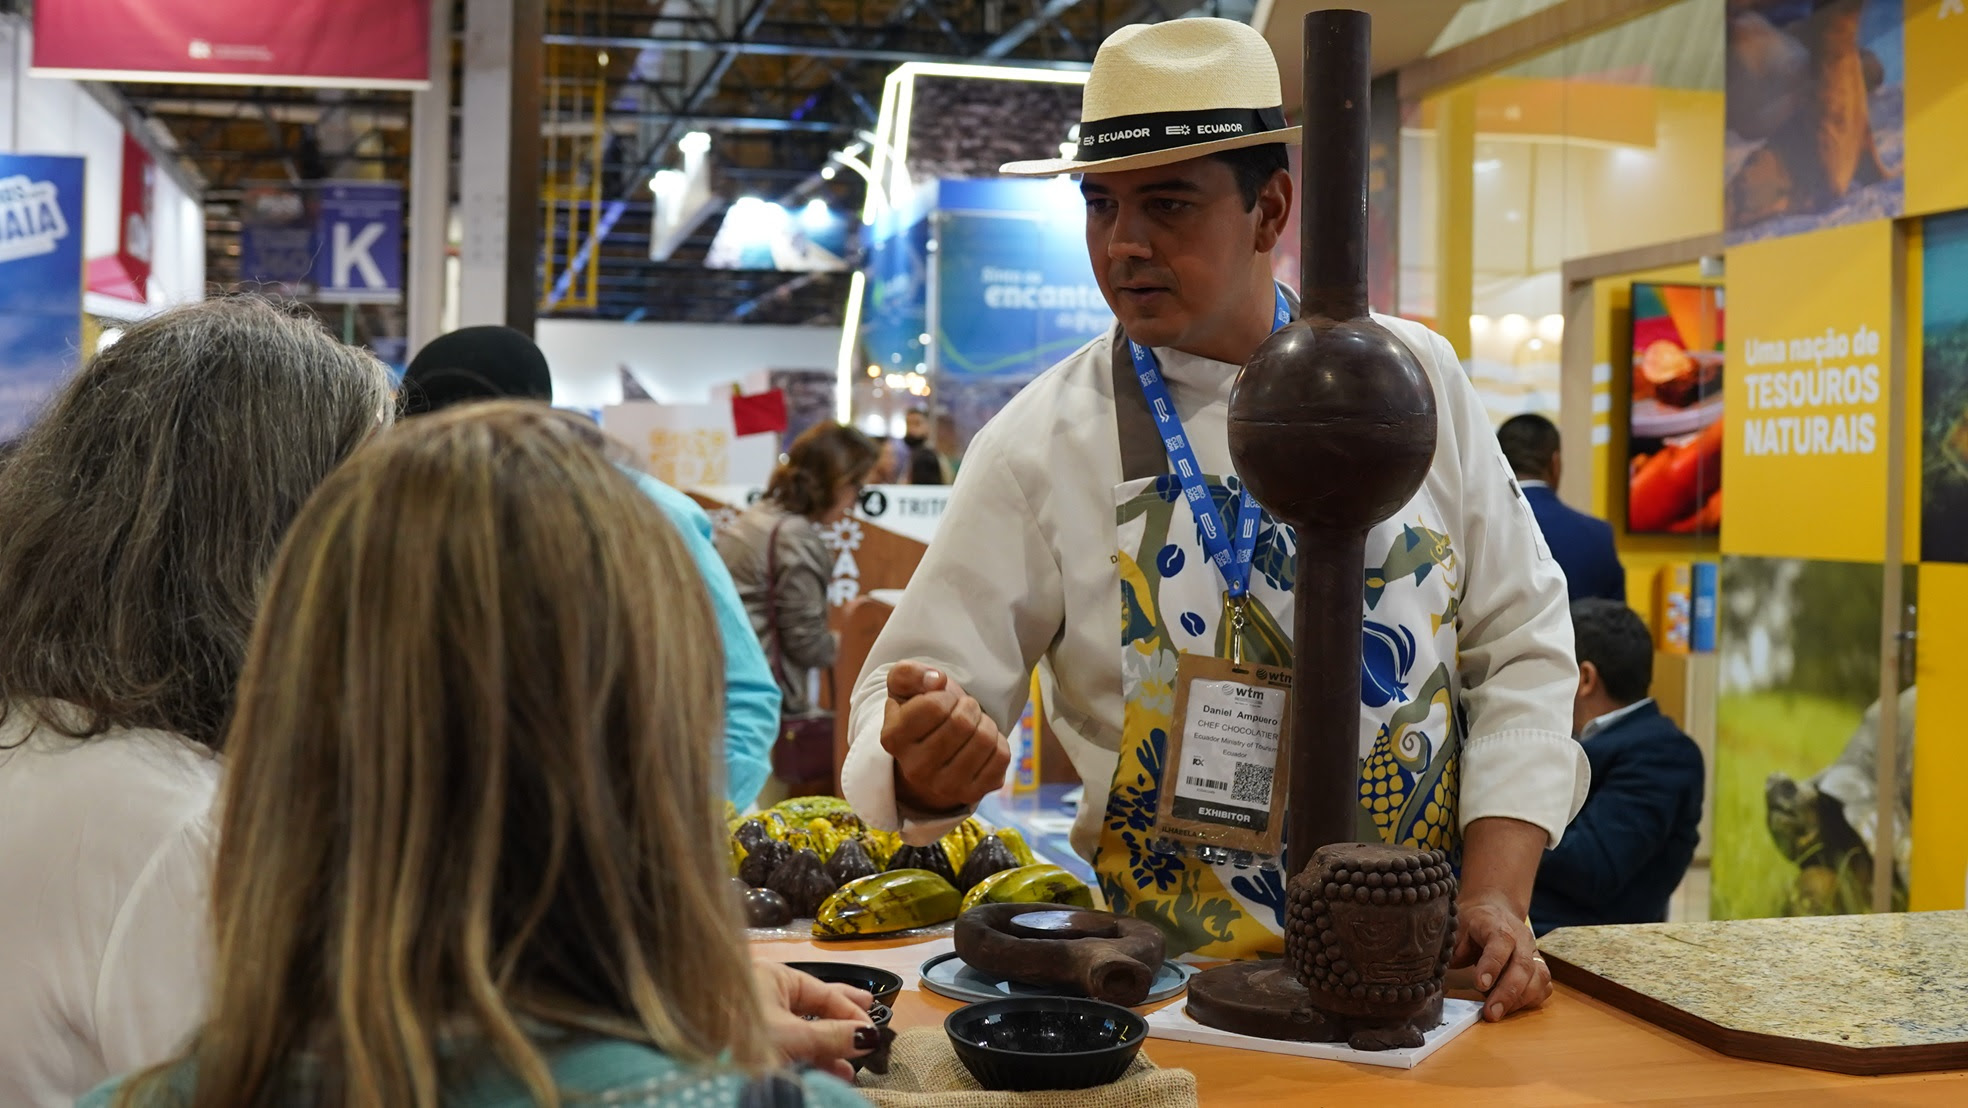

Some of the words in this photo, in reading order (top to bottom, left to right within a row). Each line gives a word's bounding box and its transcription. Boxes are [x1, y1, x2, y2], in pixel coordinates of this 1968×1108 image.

[1098, 128, 1151, 144] ECUADOR
[1197, 123, 1244, 135] ECUADOR
[0, 203, 57, 240] AIA
[332, 222, 388, 288] K
[1745, 338, 1786, 365] Uma
[1789, 327, 1849, 367] nação
[1853, 324, 1879, 356] de
[1744, 363, 1880, 411] TESOUROS
[1744, 412, 1876, 456] NATURAIS
[1236, 687, 1264, 700] wtm
[1203, 705, 1232, 717] Daniel
[1237, 711, 1278, 726] Ampuero
[1198, 719, 1220, 729] CHEF
[1221, 724, 1279, 741] CHOCOLATIER
[1193, 732, 1221, 743] Ecuador
[1221, 737, 1246, 748] Ministry
[1255, 744, 1279, 753] Tourism
[1222, 749, 1248, 758] Ecuador
[1198, 807, 1251, 823] EXHIBITOR
